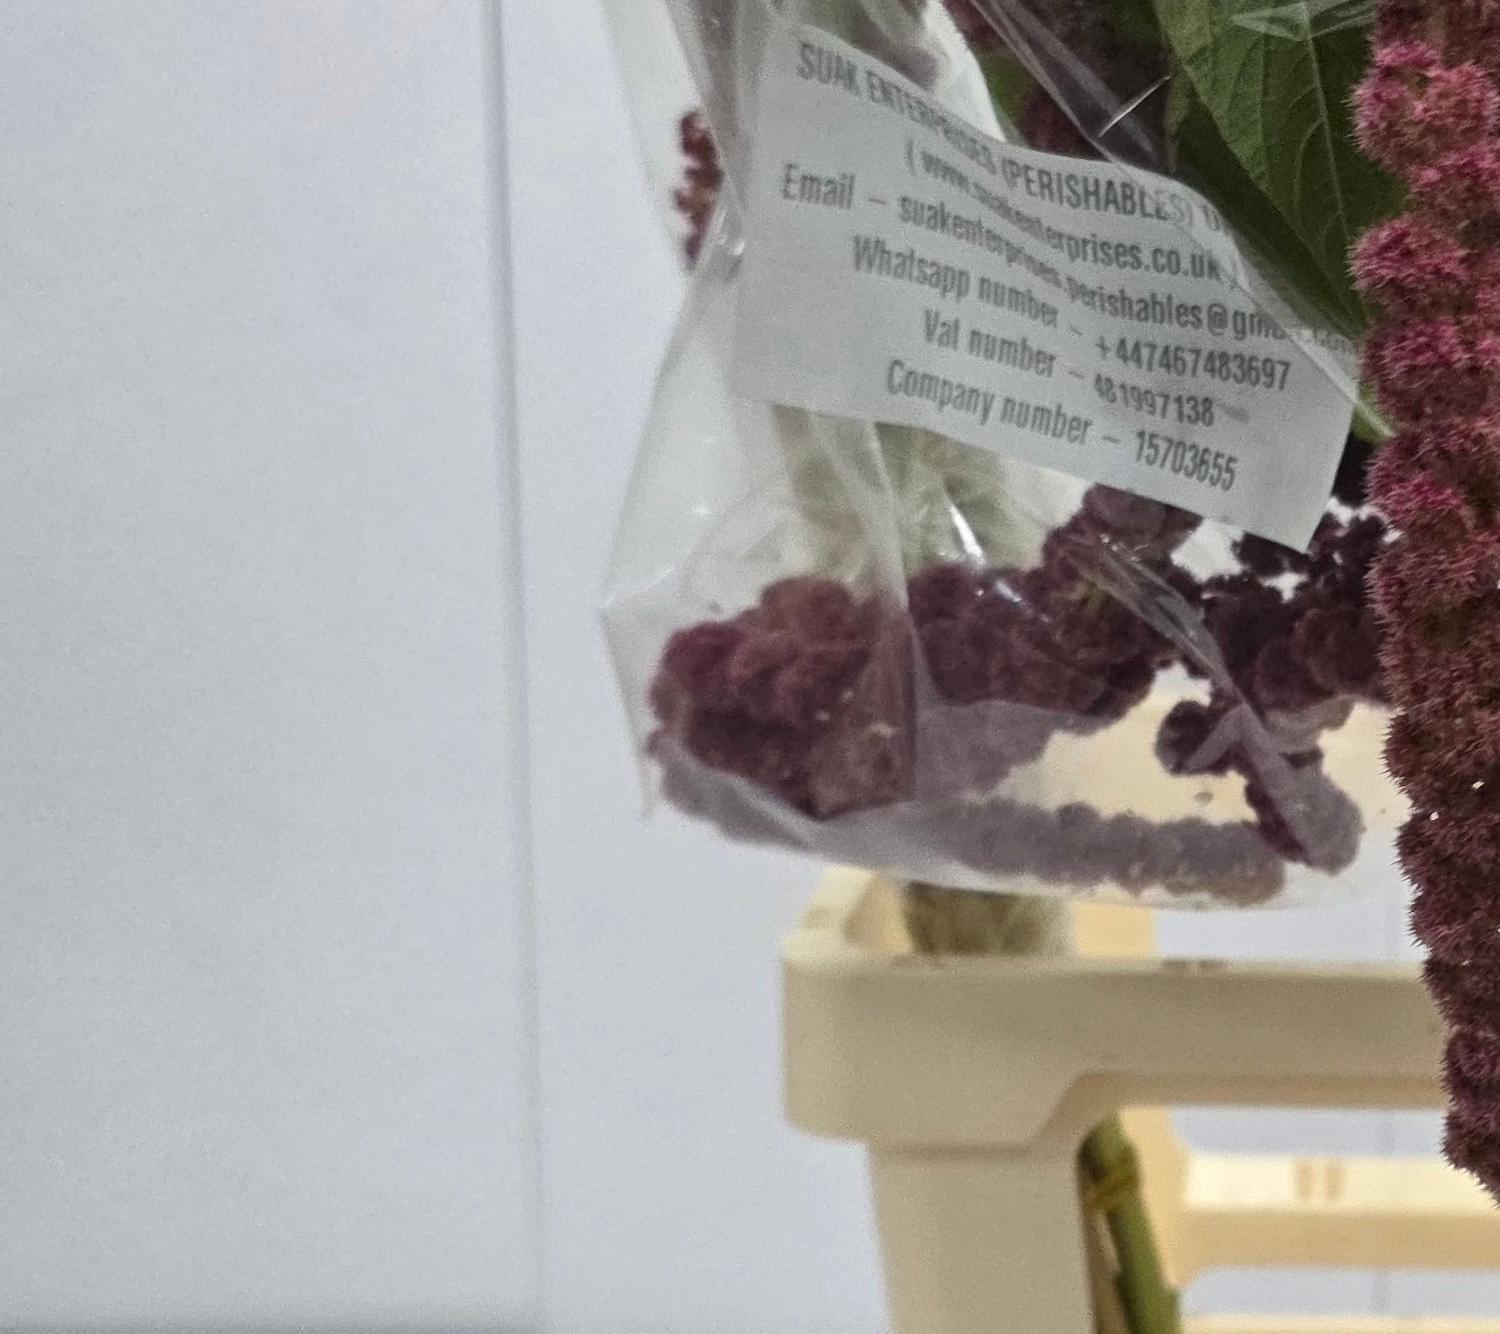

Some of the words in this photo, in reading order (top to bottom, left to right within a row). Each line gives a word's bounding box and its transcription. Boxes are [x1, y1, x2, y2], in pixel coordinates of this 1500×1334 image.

[781, 162, 855, 208] Email
[852, 234, 970, 301] Whatsapp
[978, 277, 1058, 328] number
[969, 329, 1057, 378] number
[886, 359, 996, 426] Company
[1002, 397, 1093, 445] number
[1136, 430, 1239, 491] 15703655
